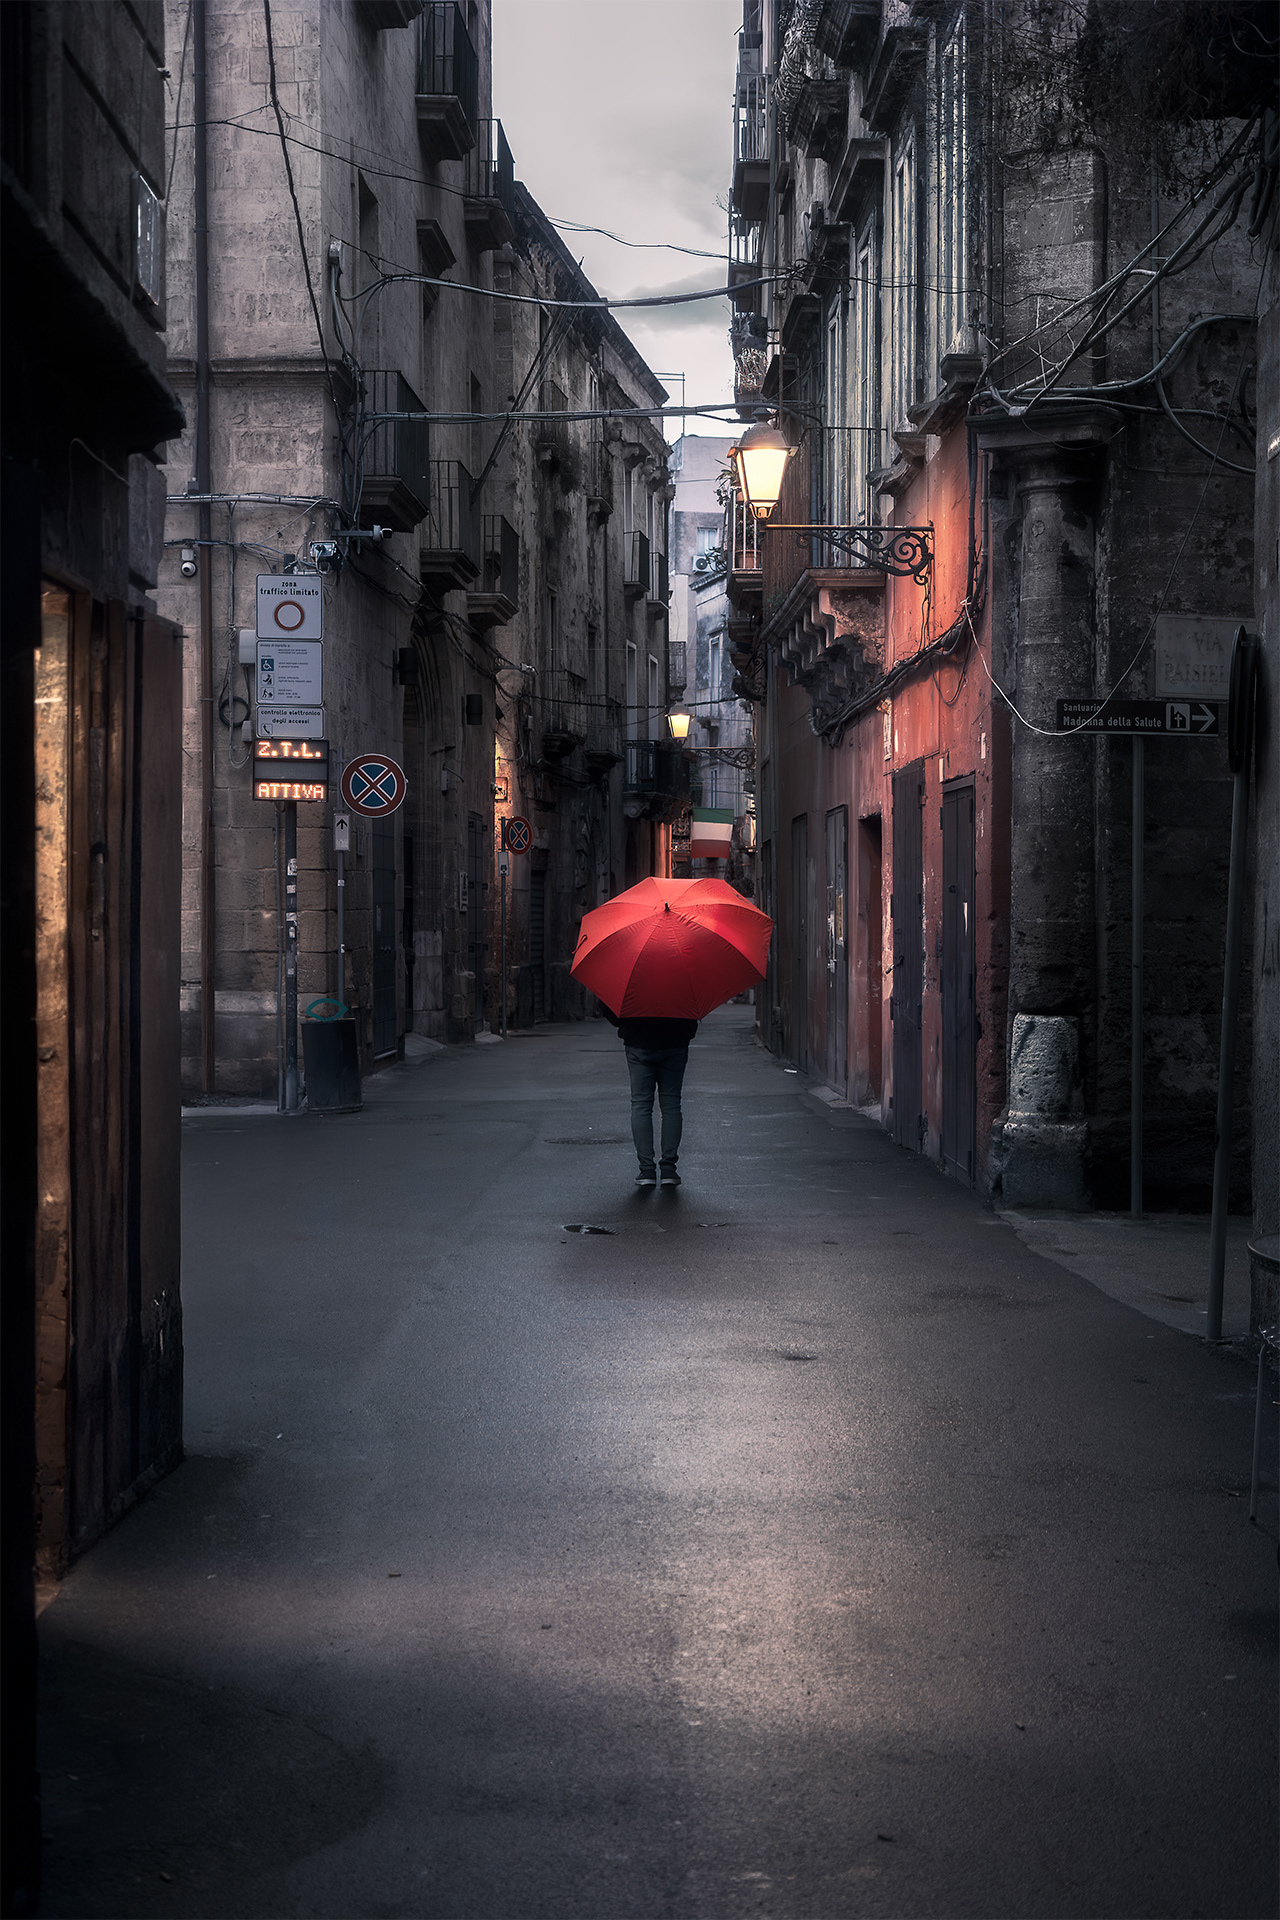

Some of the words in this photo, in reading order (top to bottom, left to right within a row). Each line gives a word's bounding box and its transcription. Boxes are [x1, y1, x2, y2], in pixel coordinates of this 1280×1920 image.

[289, 588, 319, 596] limitato
[1193, 631, 1224, 652] VIA
[1164, 663, 1229, 683] PAISIEL
[1063, 703, 1101, 712] Santuario
[1107, 716, 1132, 727] della
[1135, 717, 1162, 727] Salute
[258, 741, 321, 757] Z.T.L.
[258, 783, 324, 799] ATTIVA
